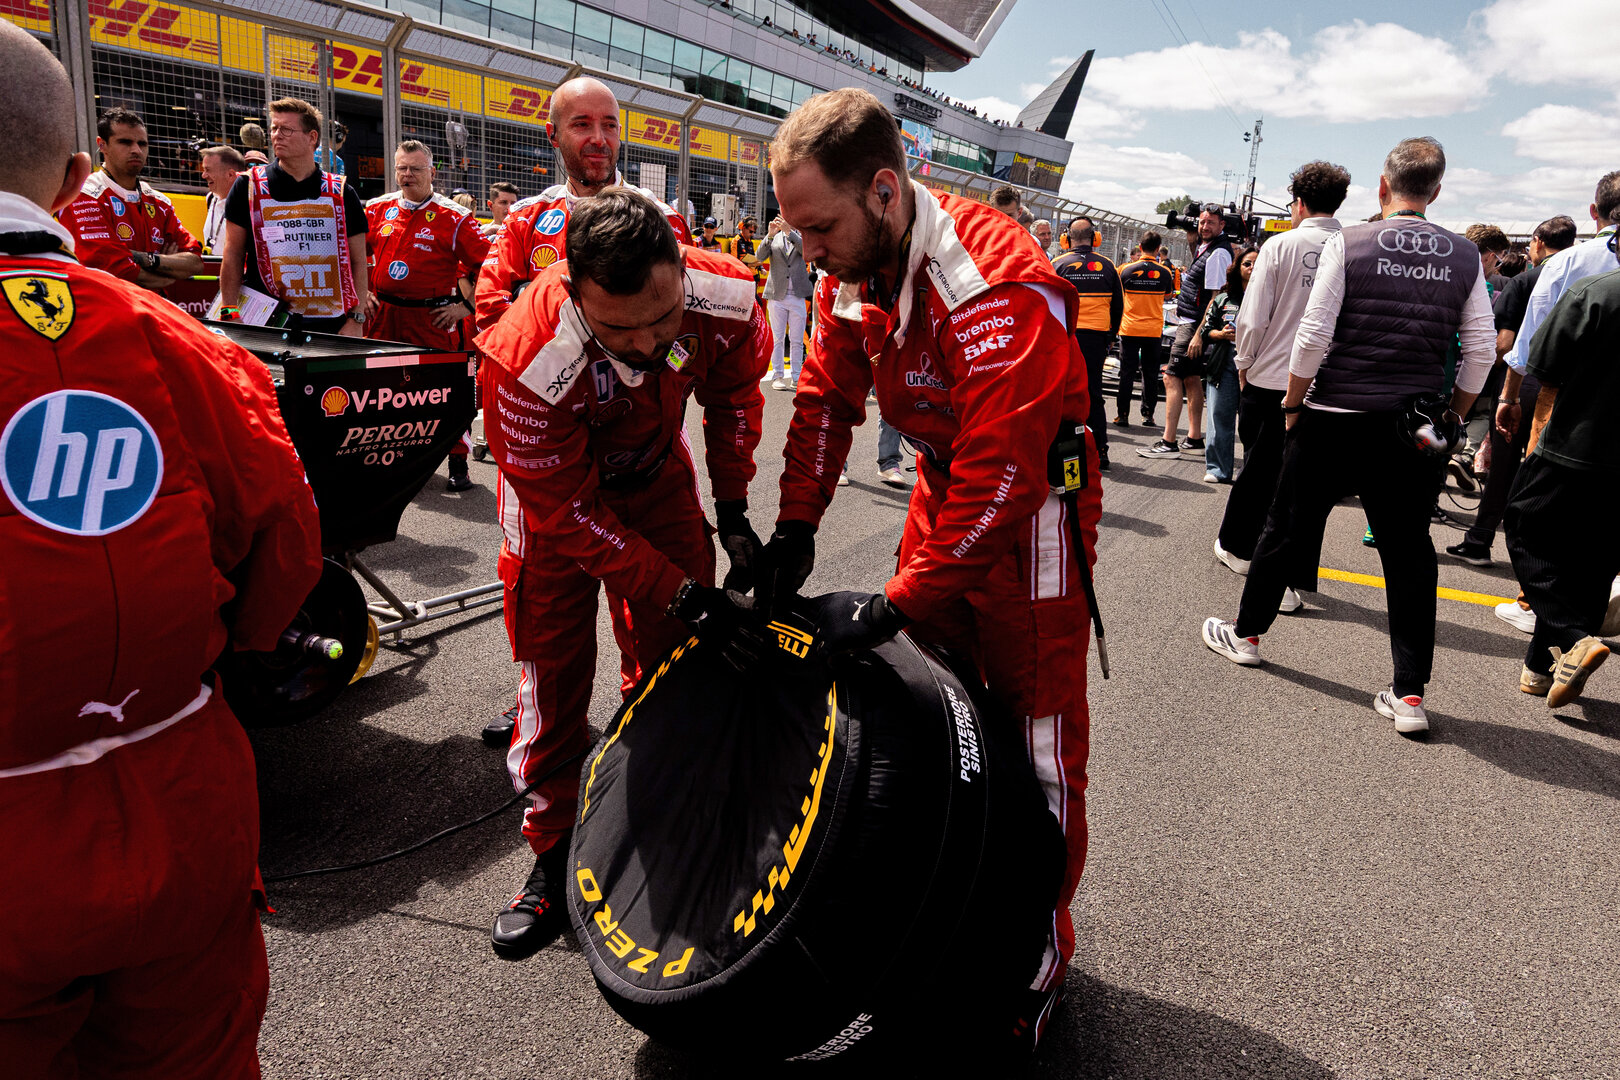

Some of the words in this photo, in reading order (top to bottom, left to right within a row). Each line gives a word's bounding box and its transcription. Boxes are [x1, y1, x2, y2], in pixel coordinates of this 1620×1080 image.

[537, 212, 563, 234] hp
[273, 233, 332, 243] RUTINEER
[298, 243, 310, 251] F1
[1376, 258, 1452, 282] Revolut
[178, 299, 211, 312] emb
[711, 303, 748, 314] TECHNOLOGY
[951, 298, 1009, 324] Bitdefender
[955, 315, 1015, 343] brembo
[964, 334, 1014, 361] SKF
[546, 367, 574, 397] DXC
[568, 351, 586, 371] TECHN
[974, 360, 1017, 373] ManpowerGro
[906, 372, 948, 390] UniCred
[350, 387, 452, 413] V-Power
[497, 384, 550, 413] Bitdefender
[497, 399, 549, 429] brembo
[340, 419, 440, 448] PERONI
[336, 444, 379, 456] NASTRO
[381, 438, 432, 449] AZZURRO
[363, 450, 404, 466] 0.0%
[27, 394, 143, 531] hp
[952, 506, 997, 559] RICHARD
[993, 463, 1018, 505] MILLE
[589, 521, 626, 550] RCHARD
[943, 683, 971, 783] POSTERIORE
[959, 700, 981, 774] SINISTRO
